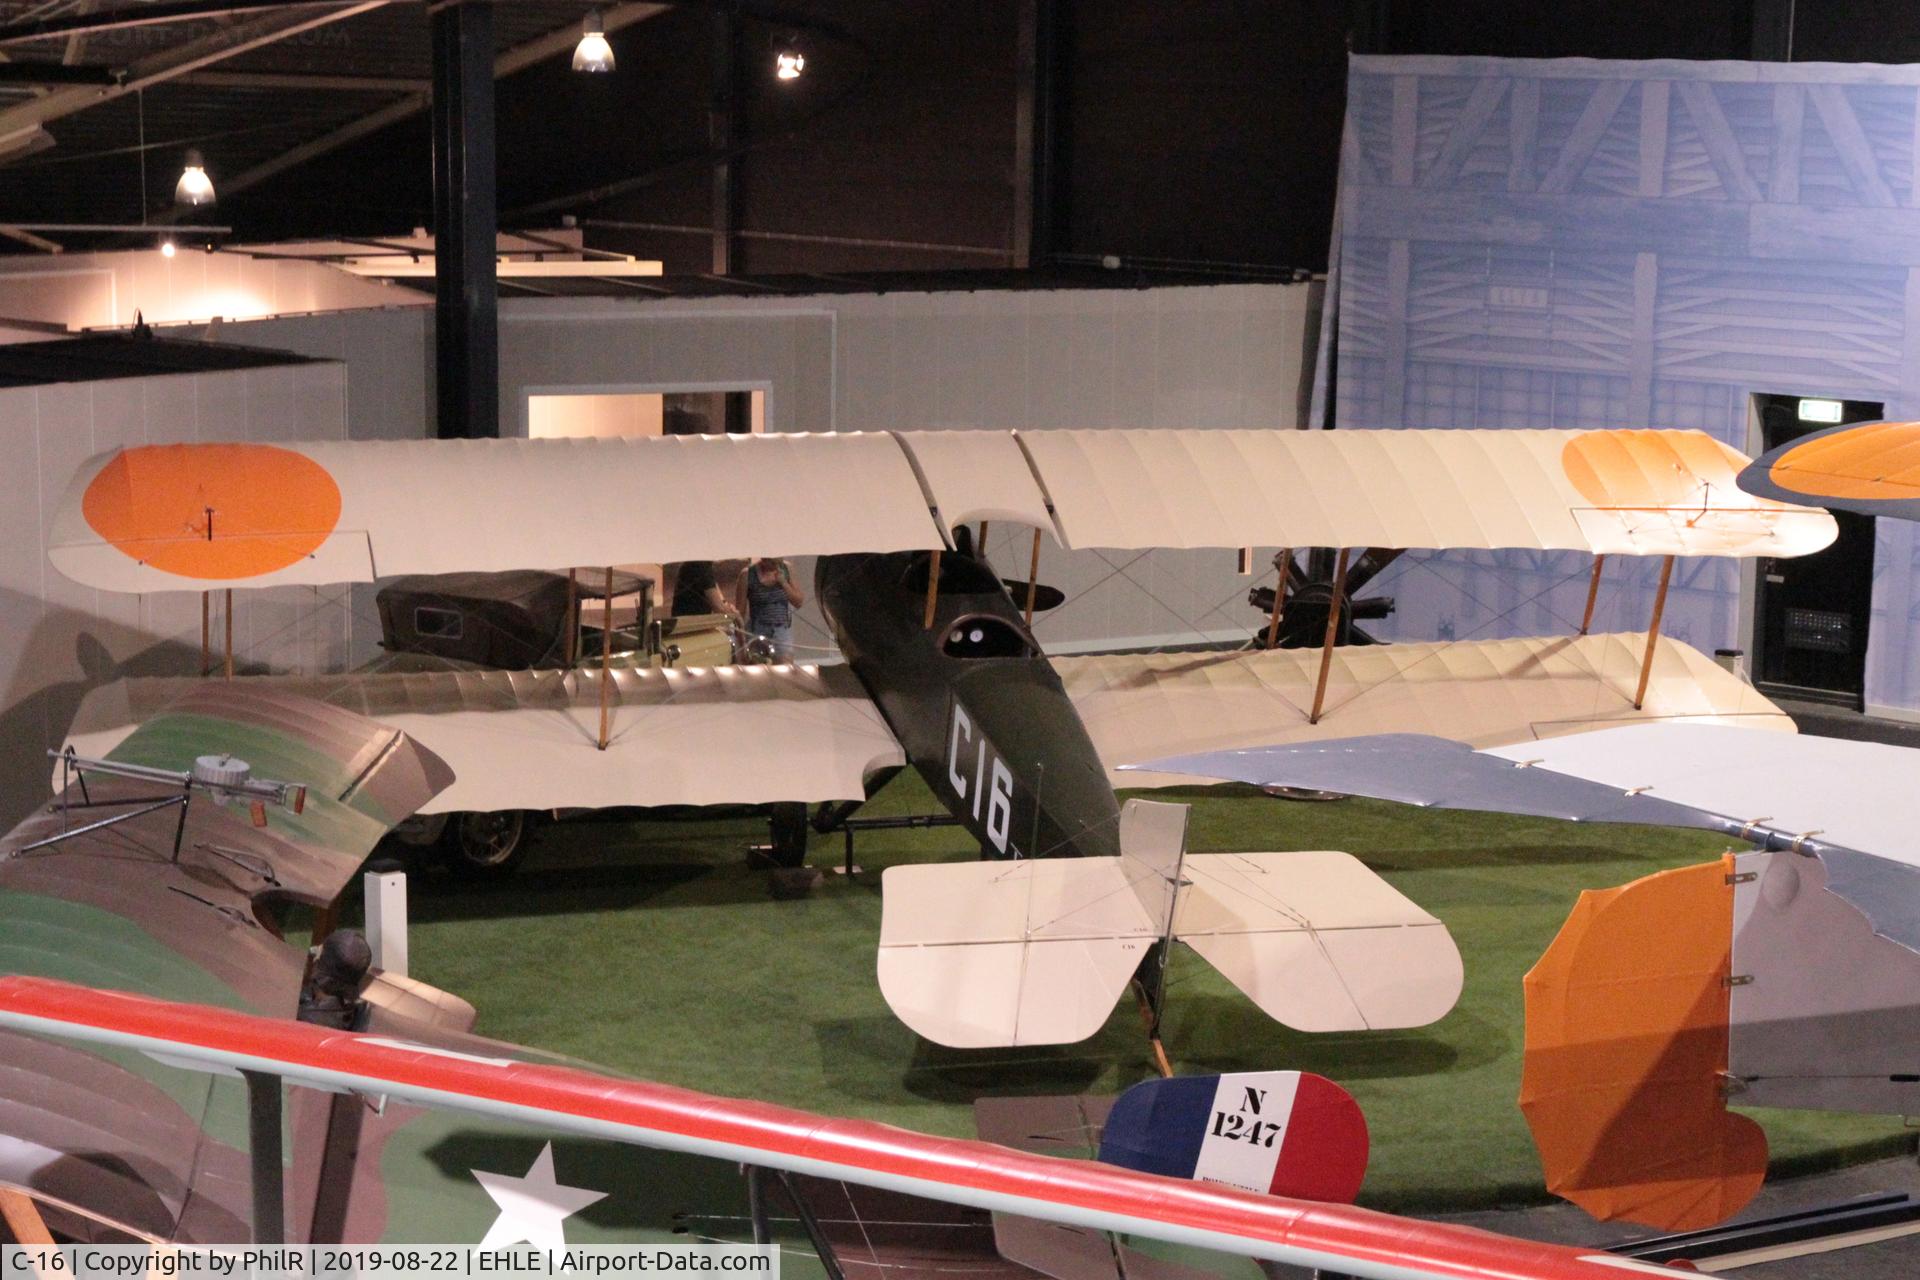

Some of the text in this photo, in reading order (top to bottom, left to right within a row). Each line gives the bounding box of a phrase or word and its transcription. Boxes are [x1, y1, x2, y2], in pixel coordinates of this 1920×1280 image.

[949, 703, 1013, 854] C16
[1240, 1086, 1267, 1115] N
[1211, 1111, 1282, 1148] 1247
